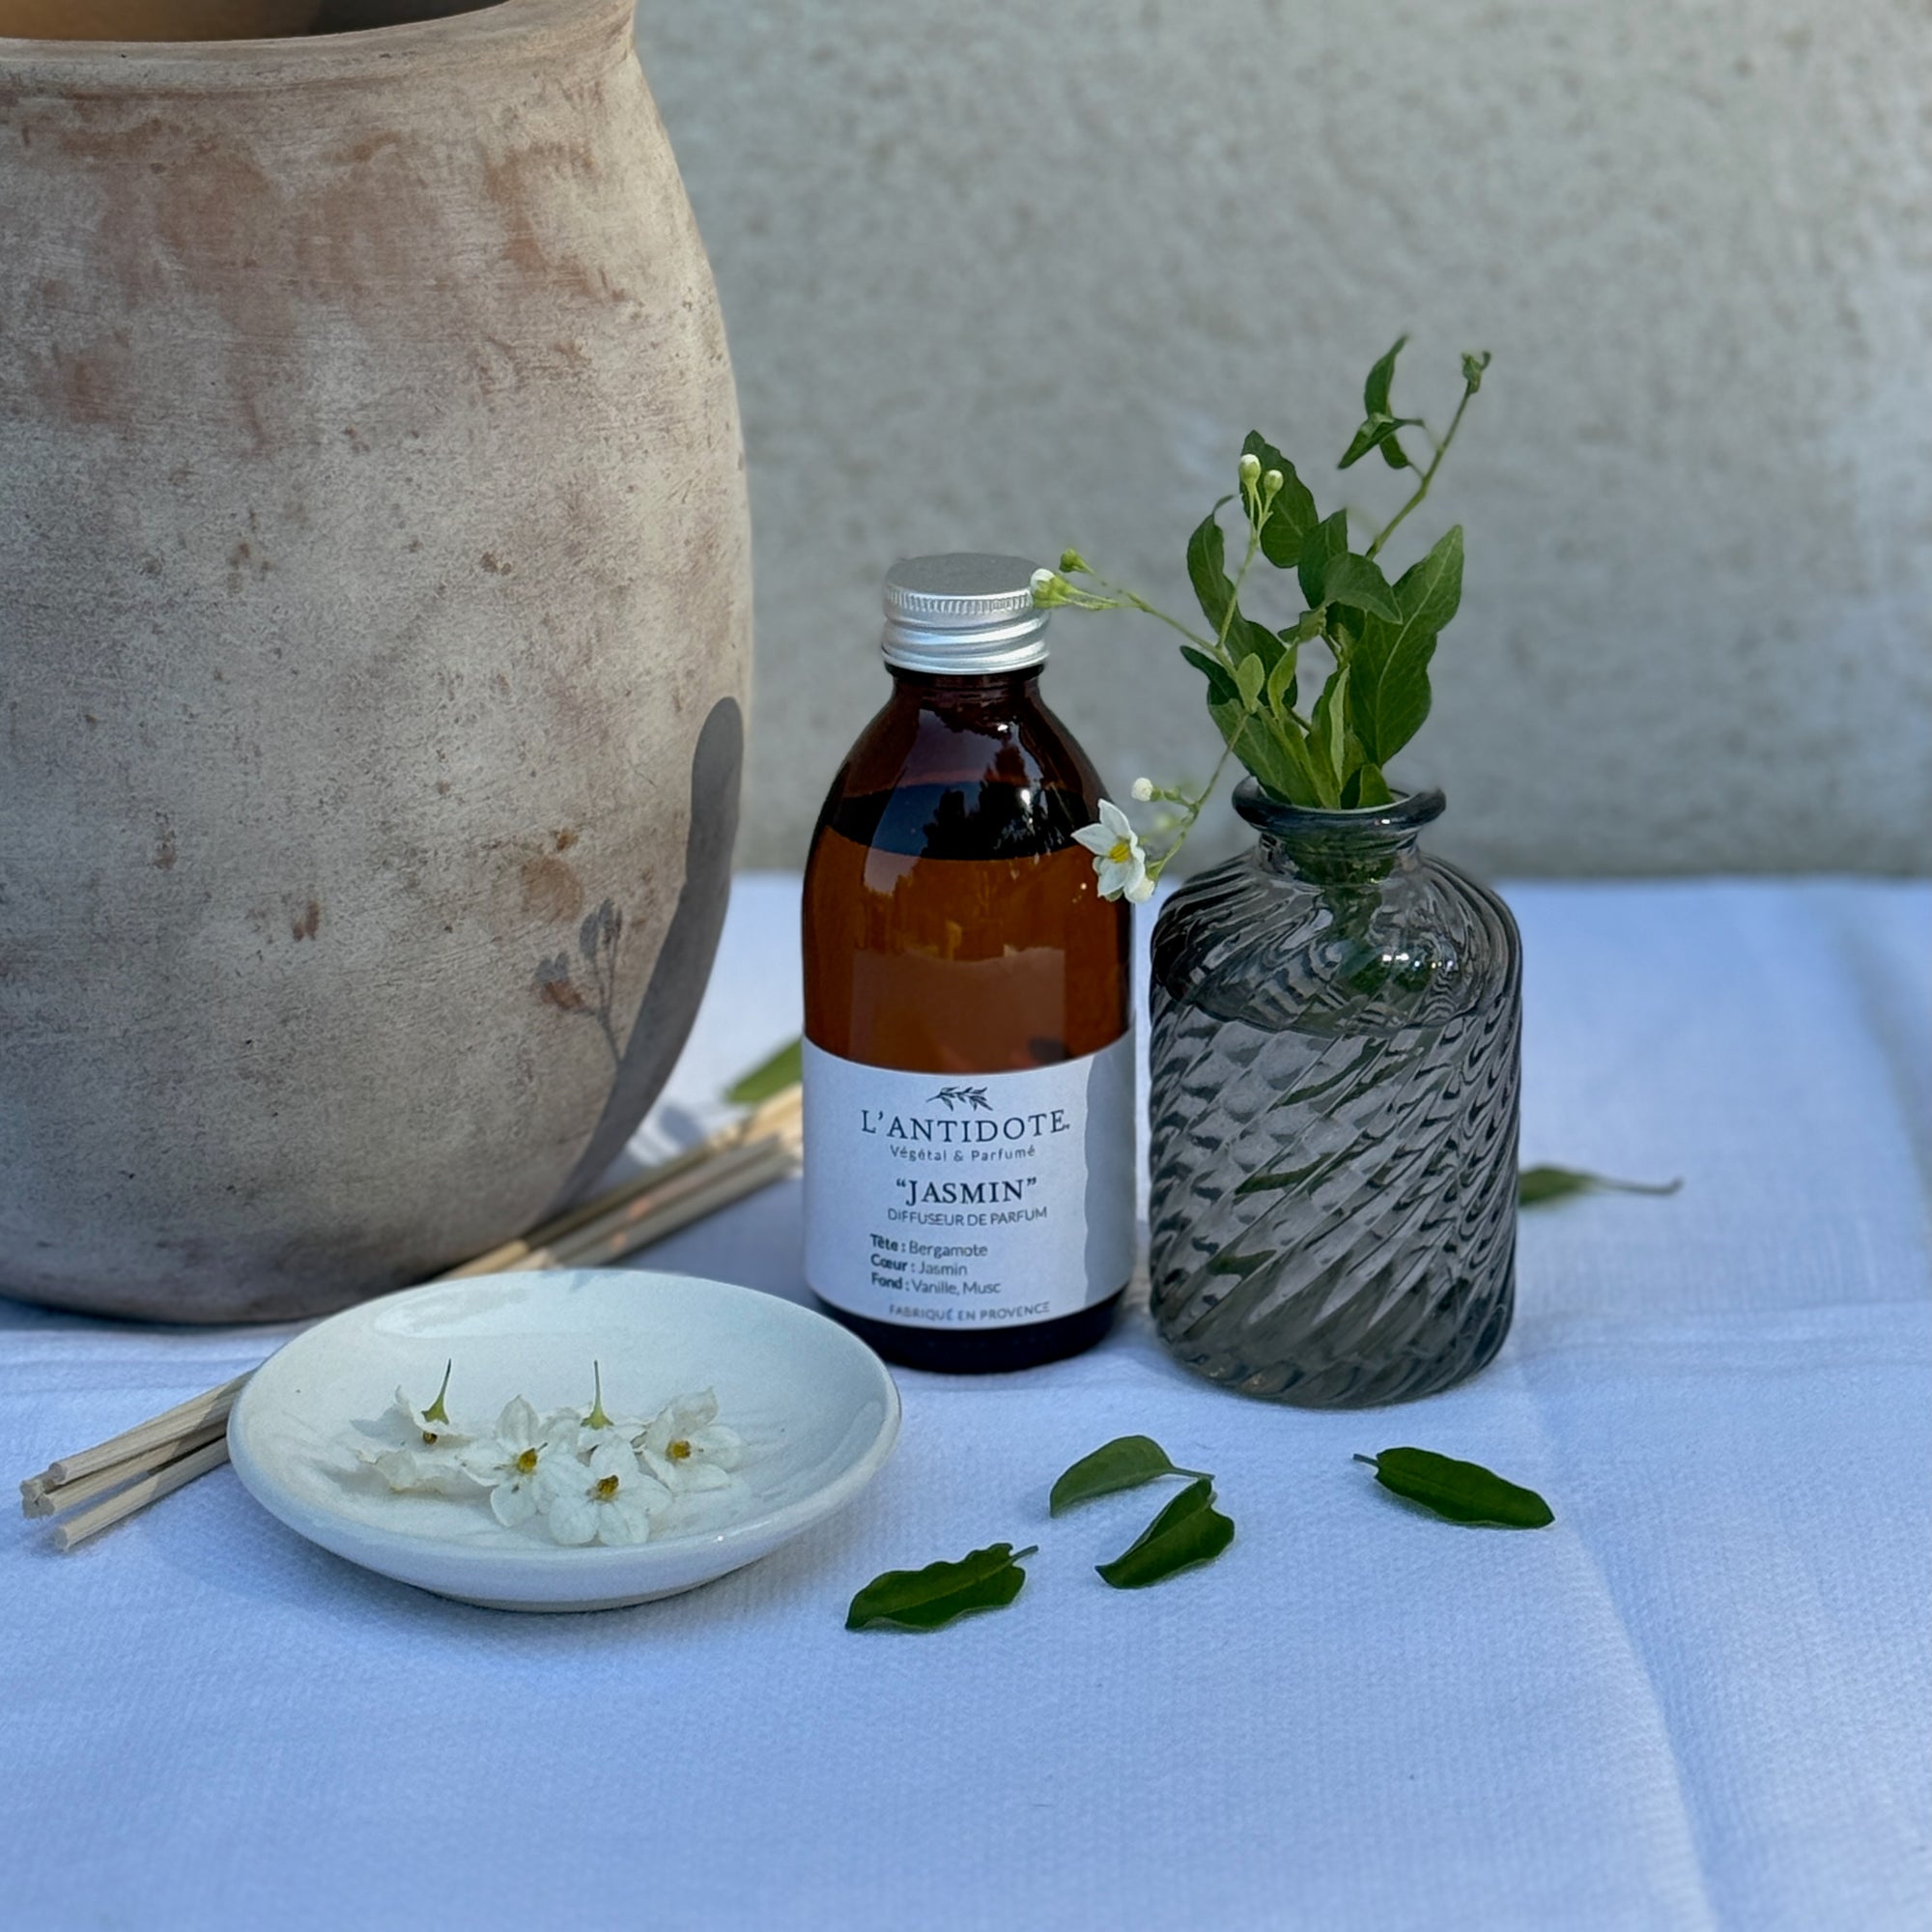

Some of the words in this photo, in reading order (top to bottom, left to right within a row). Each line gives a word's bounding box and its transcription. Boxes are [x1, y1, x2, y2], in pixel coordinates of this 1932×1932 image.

[890, 1145, 947, 1162] Végétal
[953, 1151, 964, 1162] &
[971, 1145, 1036, 1161] Parfumé
[895, 1177, 1037, 1207] “JASMIN”
[888, 1208, 965, 1226] DIFFUSEUR
[967, 1213, 986, 1226] DE
[990, 1207, 1047, 1225] PARFUM
[870, 1234, 898, 1252] Tête
[909, 1240, 988, 1259] Bergamote
[918, 1261, 968, 1276] Jasmin
[871, 1272, 903, 1290] Fond
[911, 1279, 960, 1295] Vanille,
[963, 1281, 1001, 1294] Musc
[889, 1304, 953, 1321] FABRIQUÉ
[957, 1310, 976, 1321] EN
[980, 1302, 1050, 1321] PROVENCE
